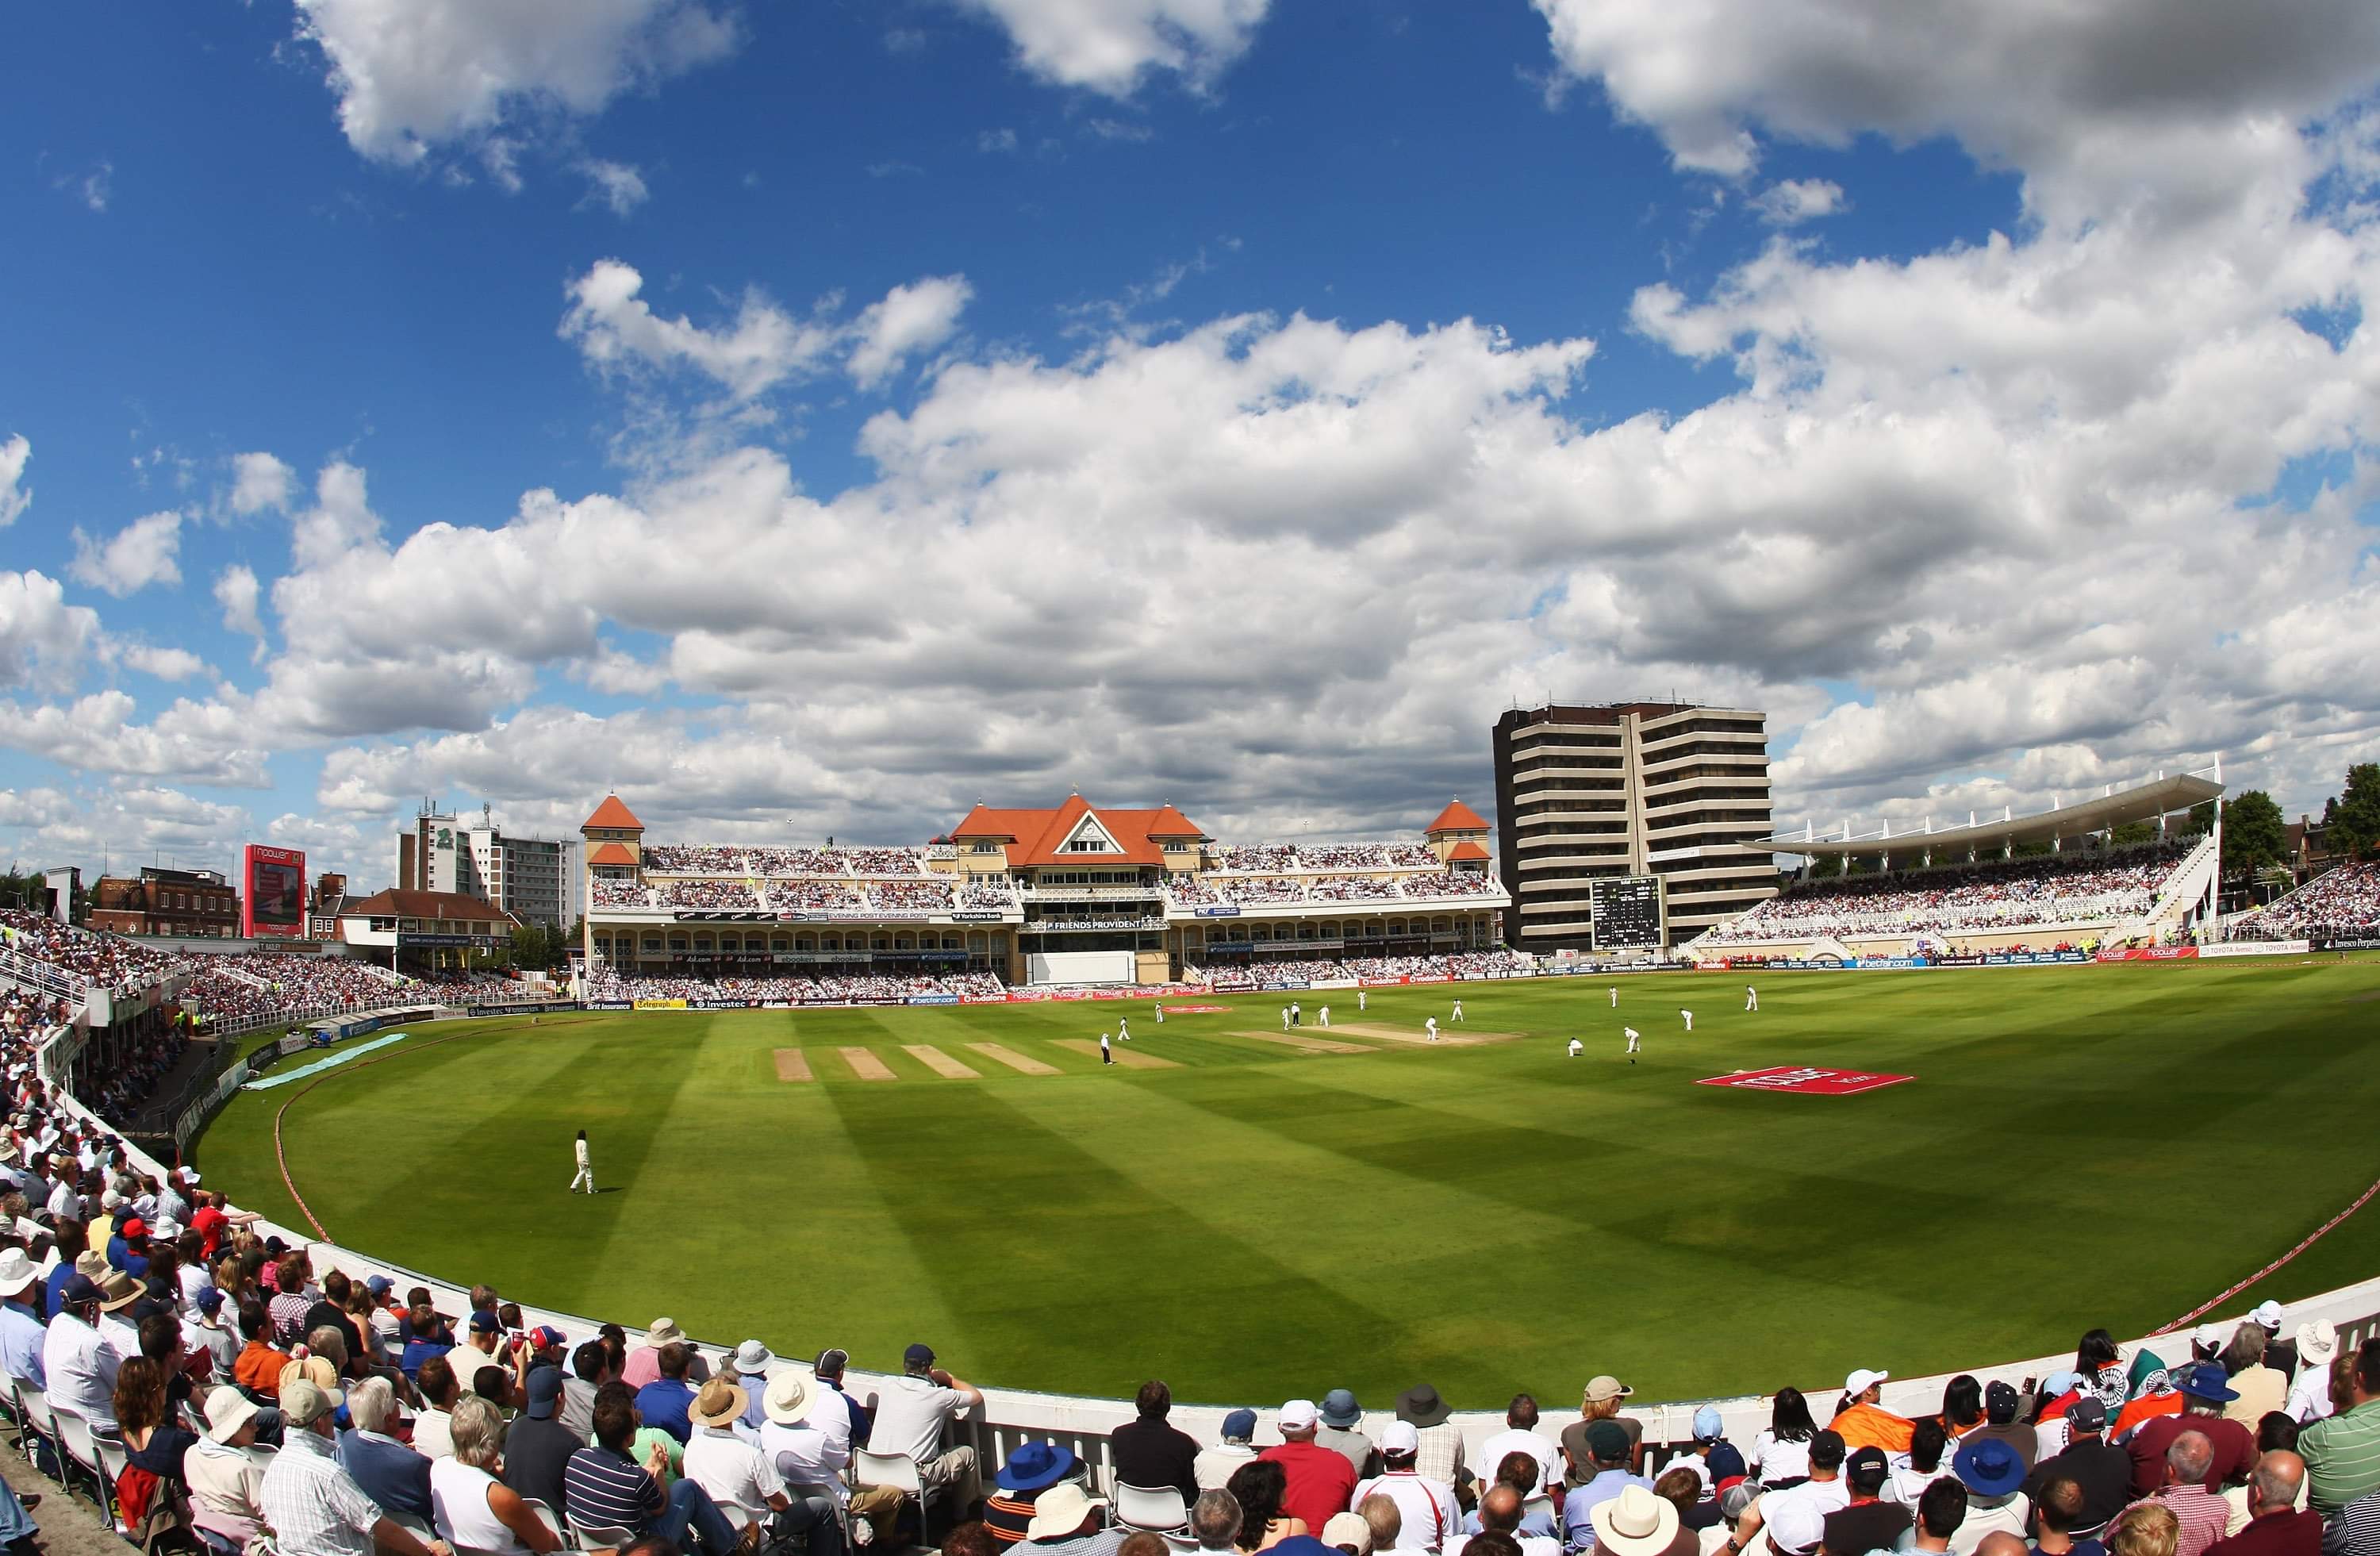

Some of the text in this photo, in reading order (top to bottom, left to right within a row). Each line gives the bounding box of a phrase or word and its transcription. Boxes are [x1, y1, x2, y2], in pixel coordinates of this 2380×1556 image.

[257, 848, 289, 859] npower
[1055, 920, 1140, 930] FRIENDS PROVIDENT
[2336, 939, 2357, 947] Invesco
[1631, 963, 1658, 972] Perpetual
[1865, 959, 1914, 967] betfair.com
[1369, 976, 1401, 985] vodafone
[1417, 974, 1448, 982] vodafone
[1464, 972, 1487, 981] OFFICIAL
[1096, 989, 1127, 998] npower
[971, 994, 1007, 1003] vodafone
[707, 1000, 746, 1009] Investec
